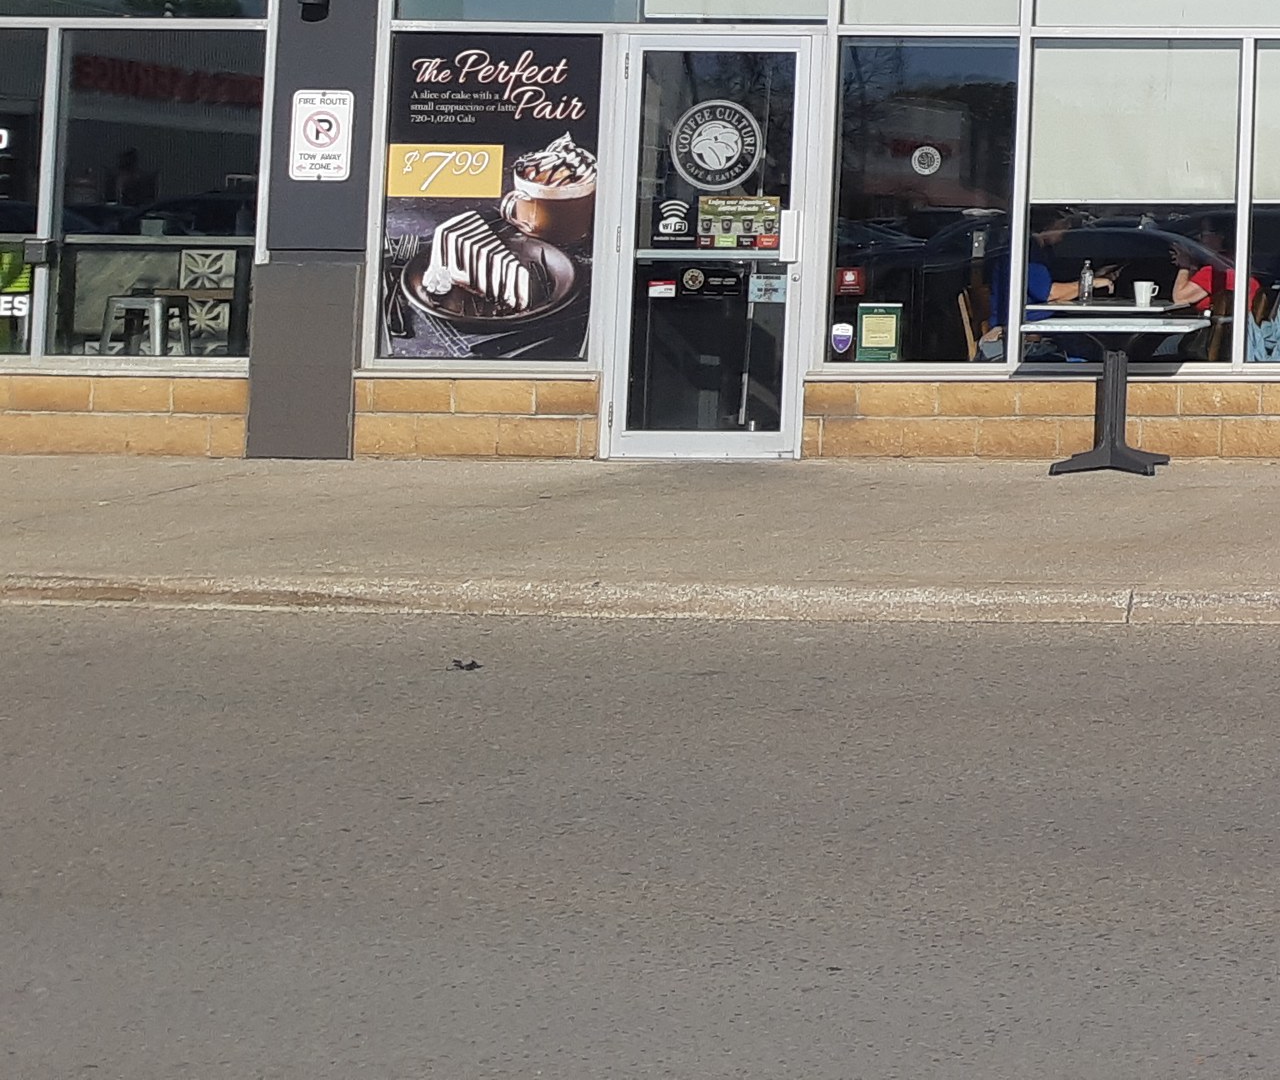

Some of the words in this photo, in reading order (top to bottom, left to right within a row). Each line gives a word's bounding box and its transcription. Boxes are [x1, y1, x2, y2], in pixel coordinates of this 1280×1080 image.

[411, 57, 453, 84] The
[454, 49, 568, 100] Perfect
[410, 90, 419, 99] A
[420, 90, 439, 99] slice
[440, 90, 451, 99] of
[451, 90, 471, 99] cake
[472, 91, 492, 100] with
[510, 86, 586, 120] Pair
[410, 102, 434, 111] small
[435, 103, 485, 113] cappuccino
[497, 103, 517, 112] latte
[456, 114, 476, 123] Cals
[678, 107, 713, 153] COFFEE
[716, 107, 755, 154] CULTURE
